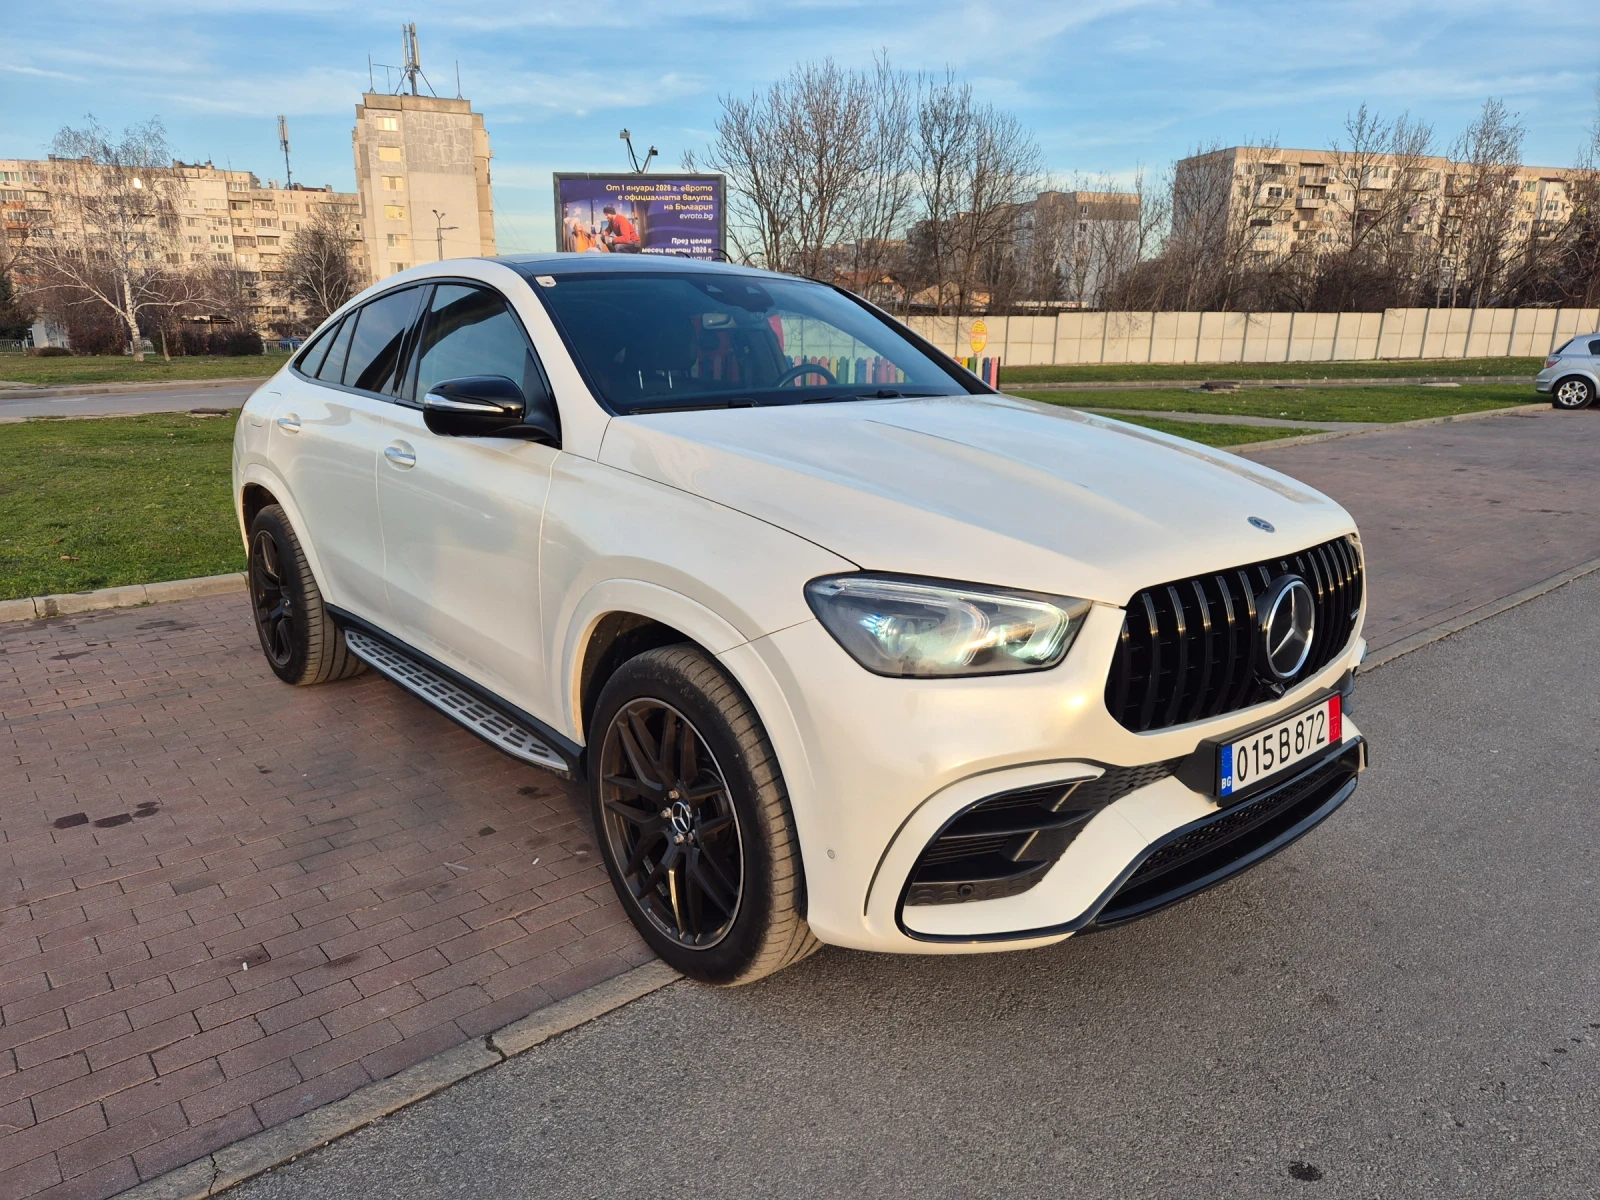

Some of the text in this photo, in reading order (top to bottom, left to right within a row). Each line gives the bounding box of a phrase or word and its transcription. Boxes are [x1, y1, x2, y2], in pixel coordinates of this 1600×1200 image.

[626, 185, 655, 193] януари
[680, 184, 713, 193] еврото
[624, 193, 681, 202] официалната
[682, 193, 713, 202] валута
[675, 203, 713, 211] България
[679, 212, 714, 220] evroto.bg
[671, 237, 689, 245] През
[1237, 710, 1326, 782] 015B872
[1221, 776, 1232, 790] BG
